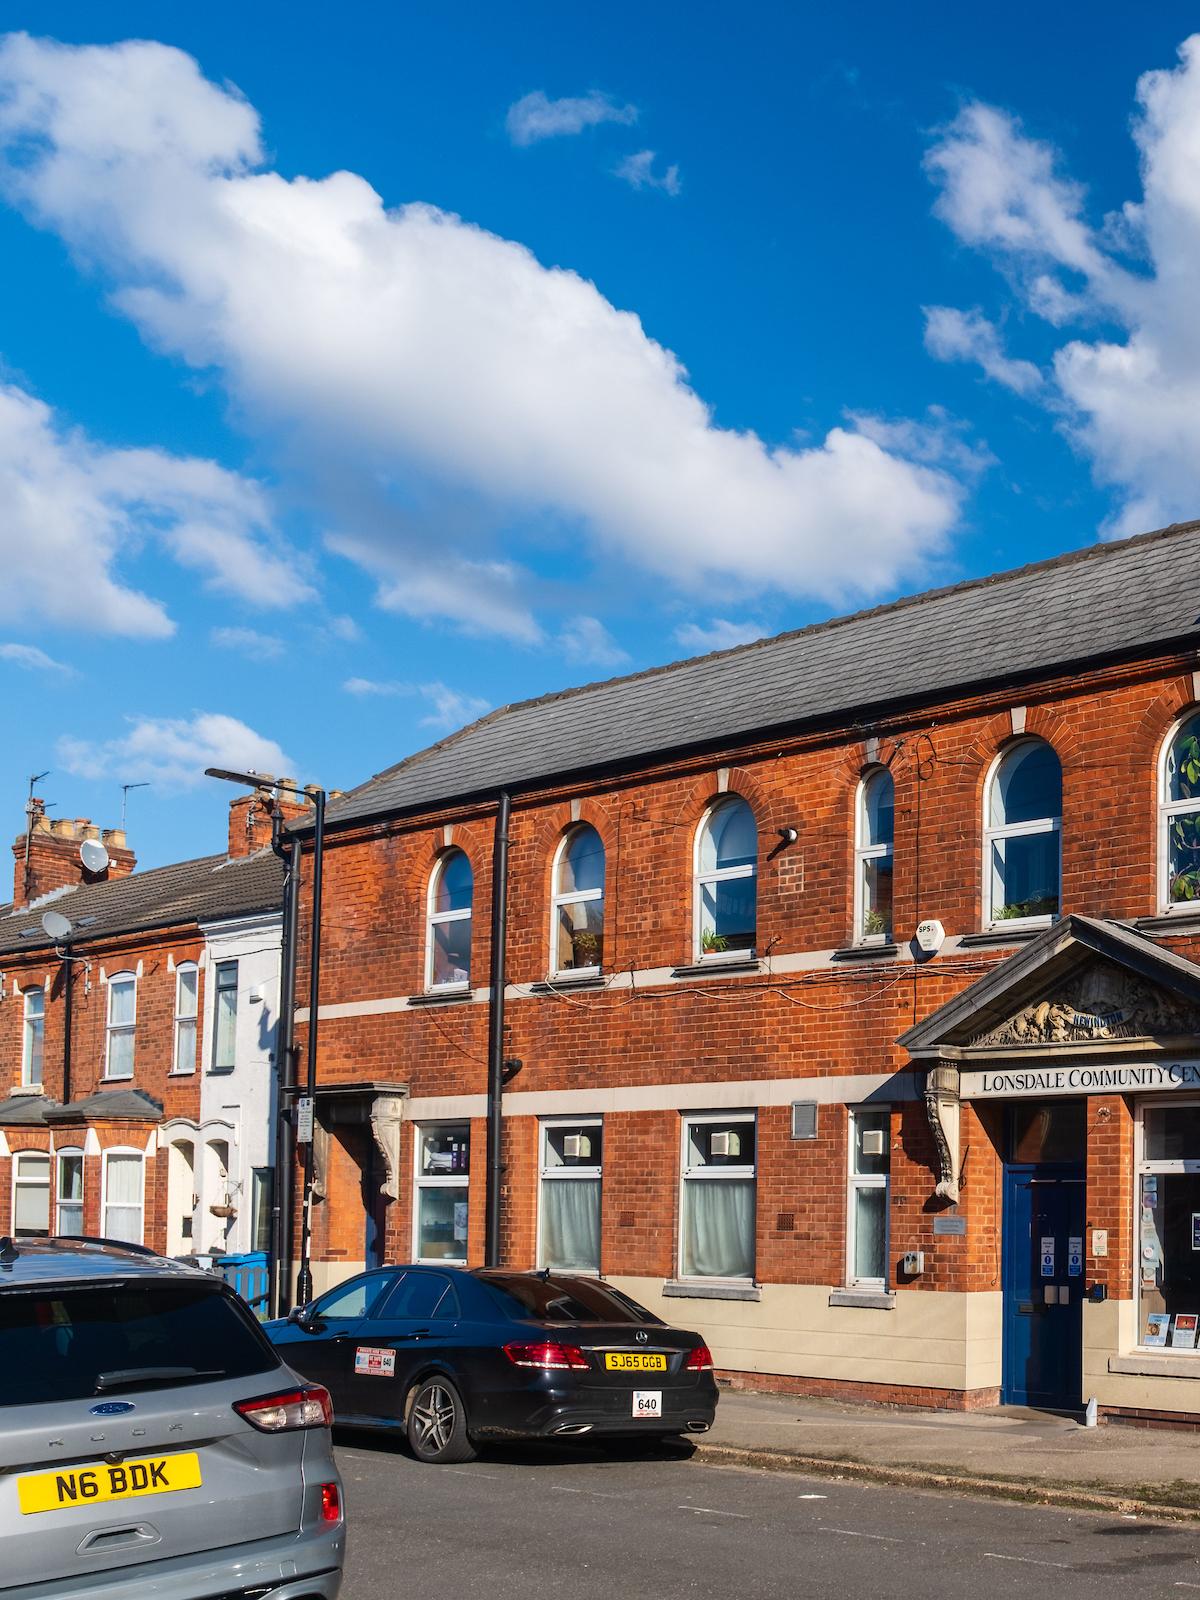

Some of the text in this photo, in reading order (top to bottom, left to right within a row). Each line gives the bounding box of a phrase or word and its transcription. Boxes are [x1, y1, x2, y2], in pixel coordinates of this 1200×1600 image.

[983, 1072, 1065, 1092] LONSDALE
[1068, 1065, 1165, 1088] COMMUNITY
[611, 1355, 662, 1368] SJ65 GGB
[638, 1399, 657, 1410] 640
[56, 1461, 170, 1502] N6 BDK
